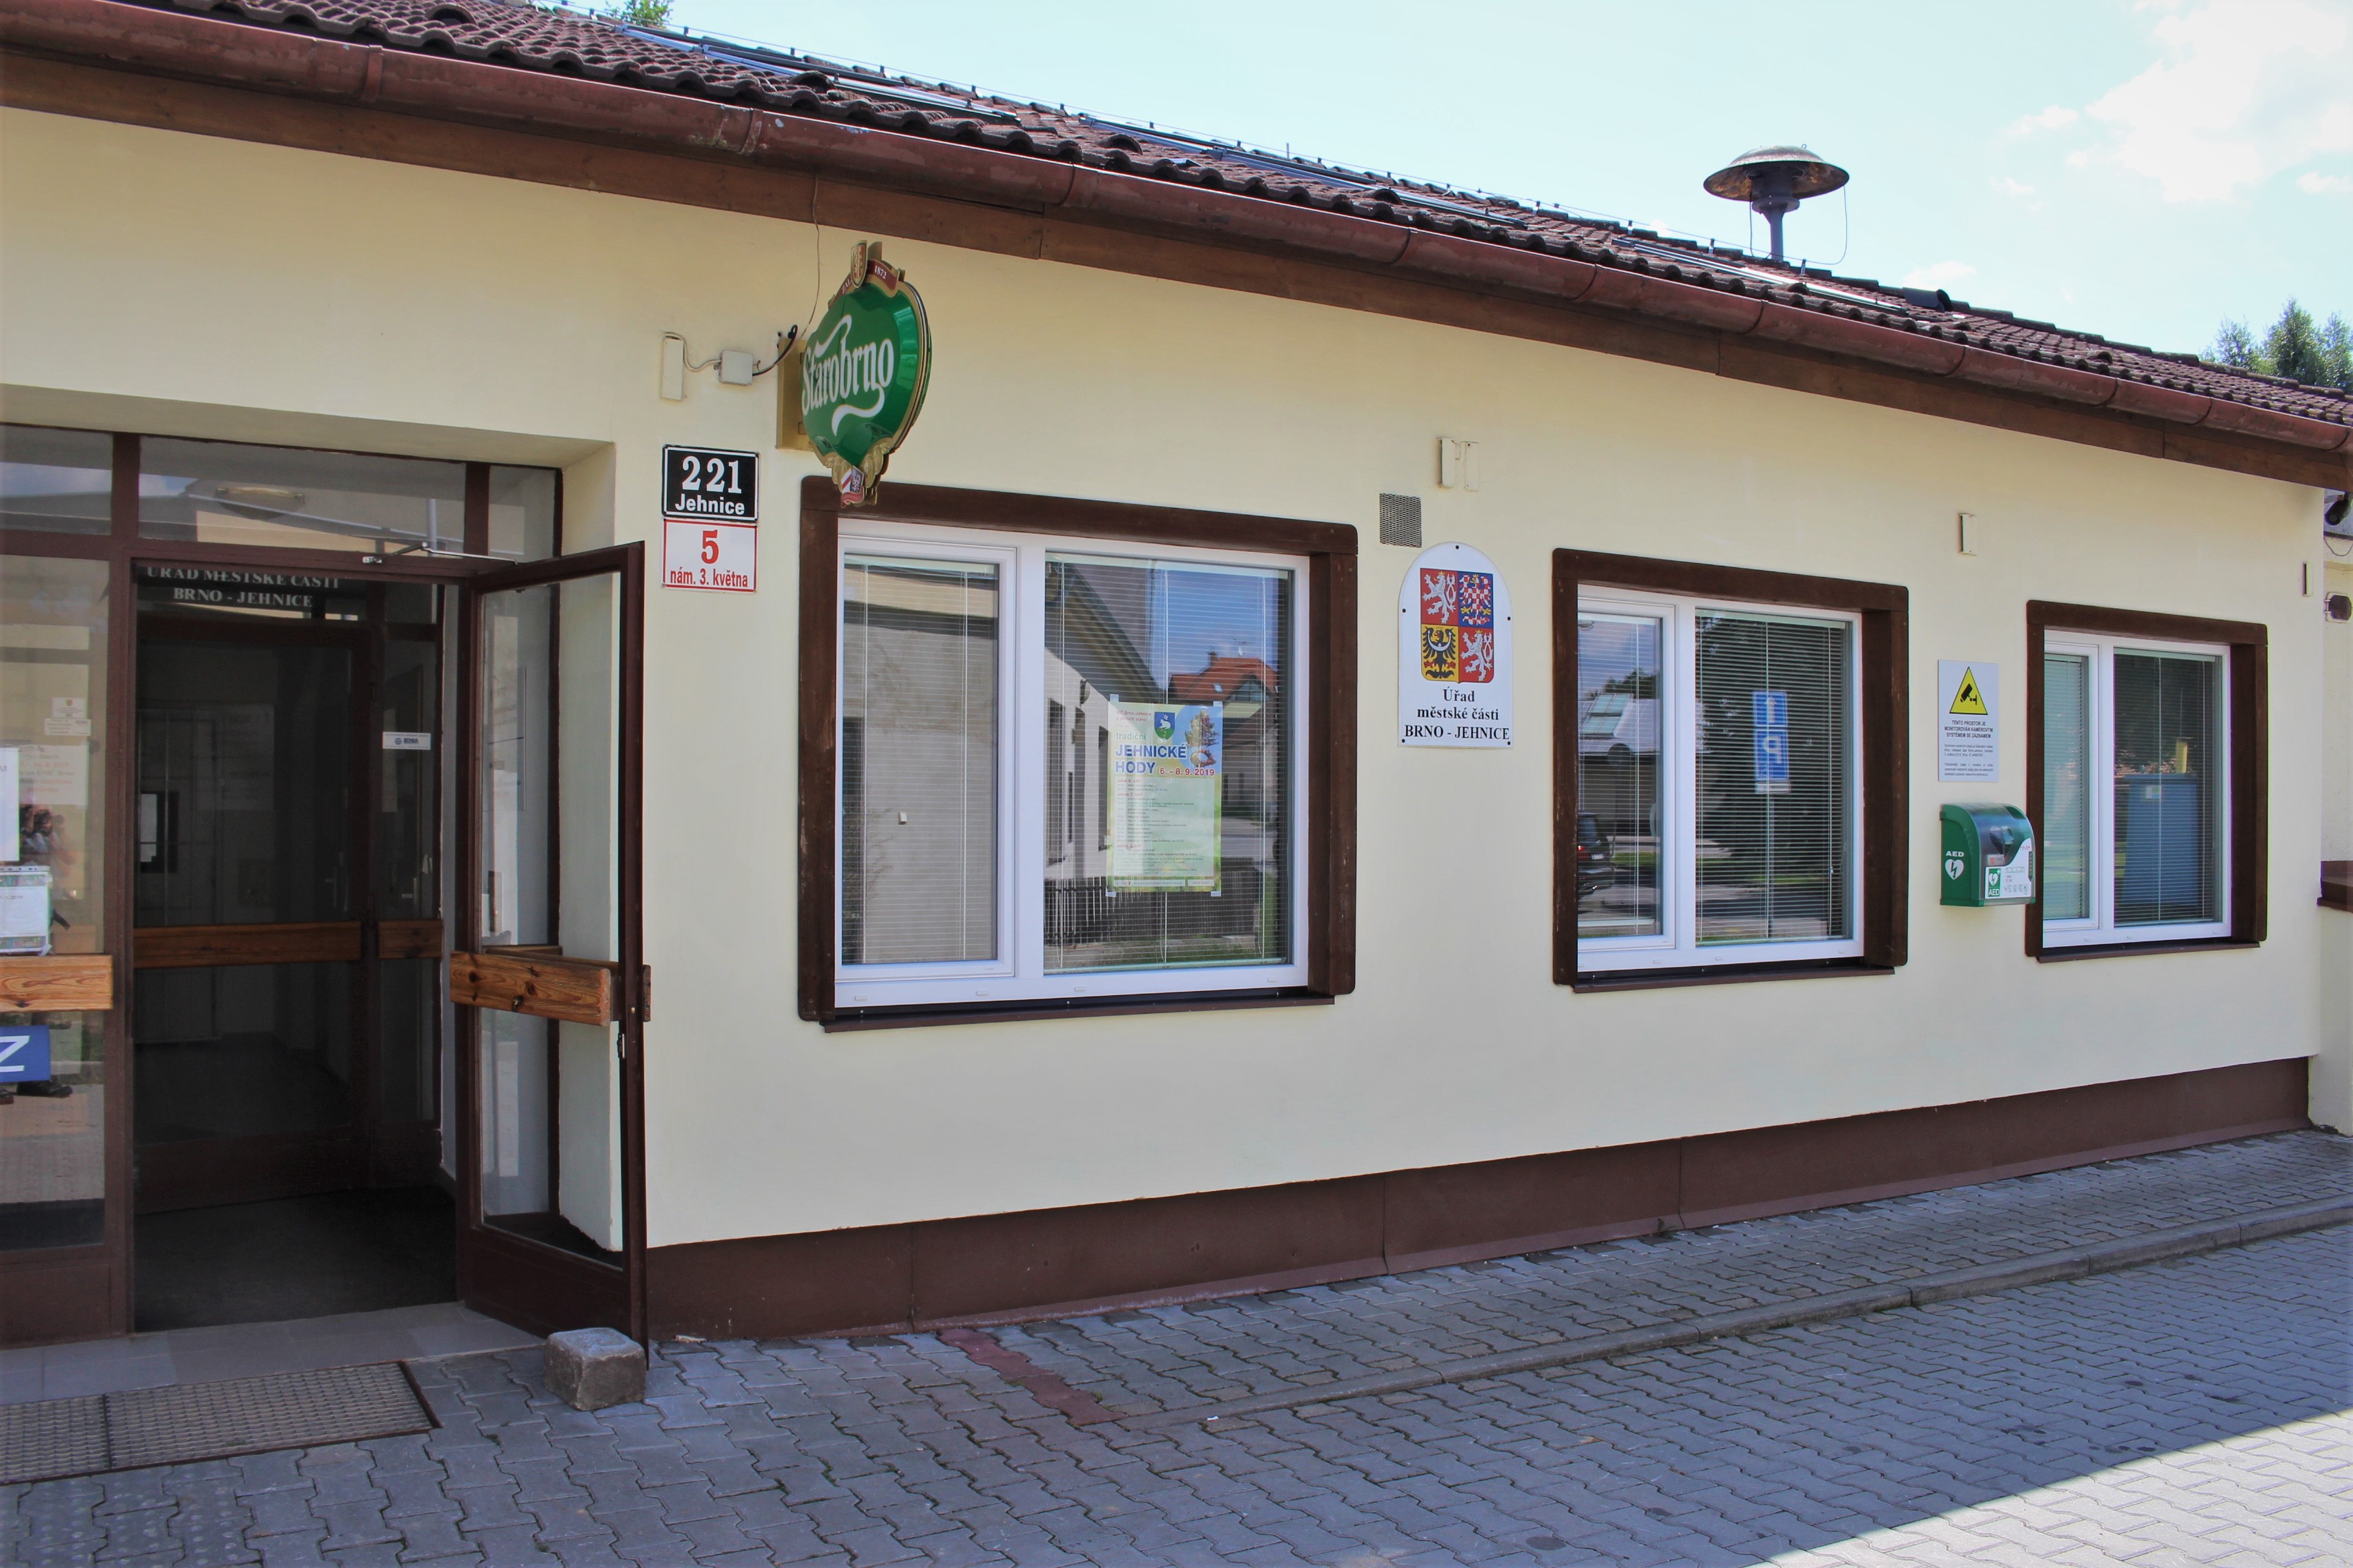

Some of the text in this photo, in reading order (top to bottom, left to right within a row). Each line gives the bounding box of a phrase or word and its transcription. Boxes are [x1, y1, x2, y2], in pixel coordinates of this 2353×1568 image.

[874, 266, 887, 280] 1872
[802, 314, 895, 436] Starobrno
[682, 455, 742, 494] 221
[675, 493, 745, 516] Jehnice
[701, 529, 719, 565] 5
[670, 567, 748, 588] nám. 3. května
[173, 587, 222, 602] BRNO
[237, 591, 313, 607] JEHNICE
[1443, 687, 1474, 702] Úřad
[1417, 707, 1498, 720] městské části
[1116, 732, 1146, 741] tradiční
[1404, 725, 1443, 738] BRNO
[1455, 726, 1510, 739] JEHNICE
[1115, 743, 1187, 758] JEHNICKÉ
[1115, 761, 1155, 774] HODY
